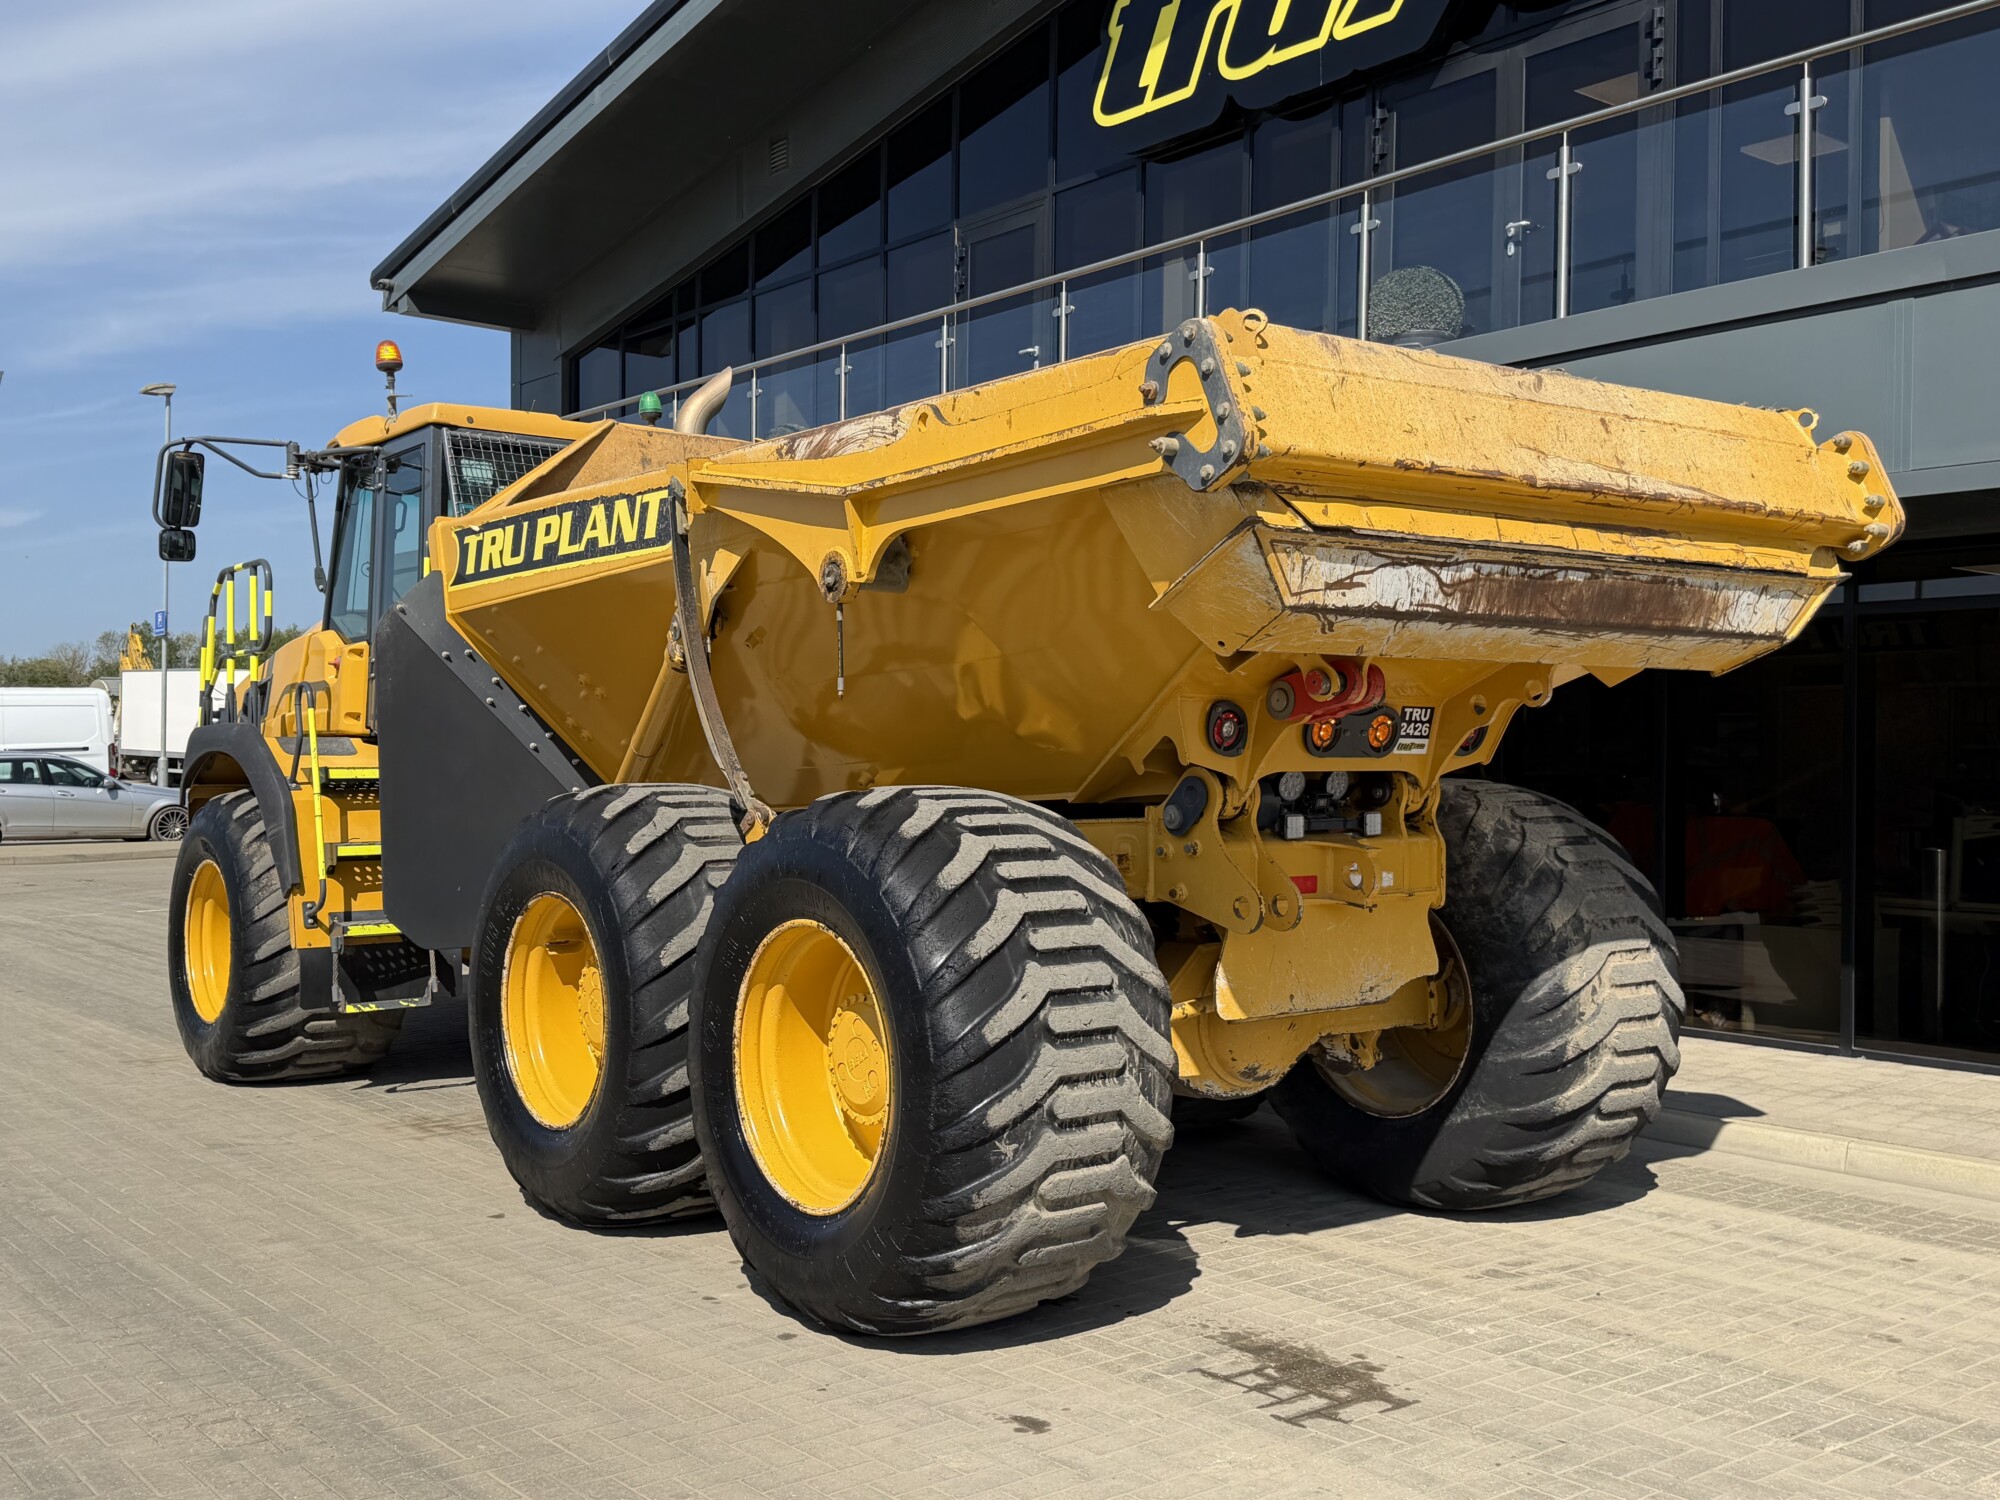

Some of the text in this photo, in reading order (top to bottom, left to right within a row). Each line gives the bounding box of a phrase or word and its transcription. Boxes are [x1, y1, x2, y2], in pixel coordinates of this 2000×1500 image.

[463, 489, 669, 576] TRU PLANT
[1404, 707, 1431, 722] TRU
[1400, 722, 1430, 737] 2426
